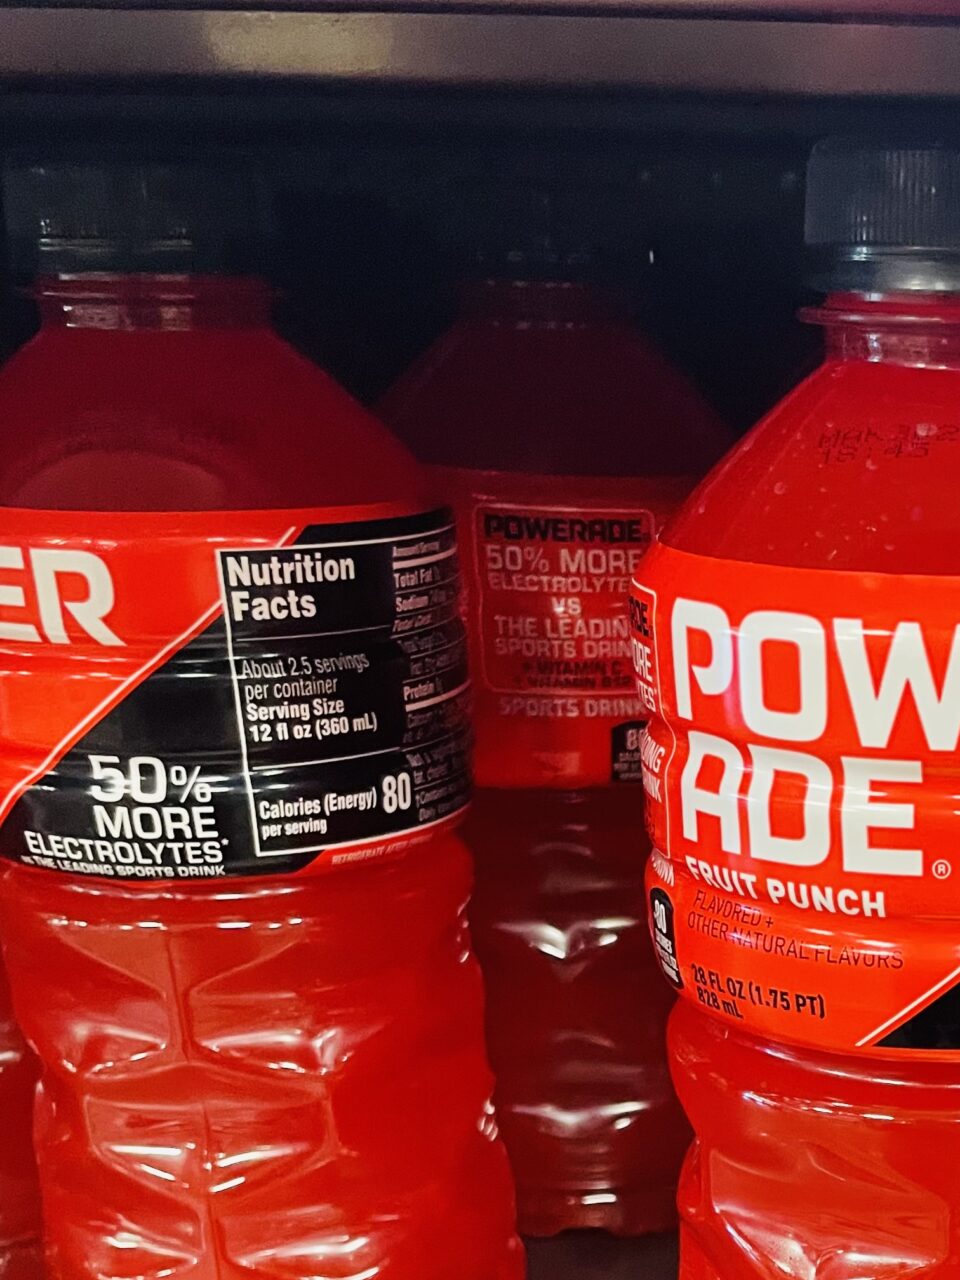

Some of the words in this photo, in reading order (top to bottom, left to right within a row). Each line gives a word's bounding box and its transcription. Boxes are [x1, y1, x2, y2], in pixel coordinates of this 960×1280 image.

[226, 553, 355, 587] Nutrition
[486, 544, 549, 572] 50%
[488, 573, 631, 593] ELECTROLYTE
[231, 590, 317, 622] Facts
[552, 597, 582, 615] VS
[494, 615, 537, 637] THE
[545, 616, 629, 639] LEADIN
[496, 638, 576, 658] SPORTS
[584, 640, 633, 658] DRIN
[242, 660, 286, 680] About
[289, 657, 312, 676] 2.5
[315, 652, 370, 673] servings
[245, 684, 269, 704] per
[273, 678, 338, 699] container
[246, 701, 310, 721] Serving
[313, 698, 344, 716] Size
[501, 698, 580, 717] SPORTS
[250, 724, 272, 742] 12
[276, 722, 289, 740] fl
[293, 724, 312, 739] oz
[316, 717, 349, 740] (360
[353, 712, 377, 732] mL)
[88, 755, 213, 804] 50%
[259, 797, 321, 820] Calories
[324, 786, 377, 816] (Energy)
[382, 772, 412, 814] 80
[93, 805, 219, 839] MORE
[261, 824, 282, 840] per
[284, 818, 327, 834] serving
[57, 860, 114, 875] LEADING
[116, 865, 175, 877] SPORTS
[178, 865, 226, 877] DRINK
[685, 855, 758, 900] FRUIT
[765, 878, 886, 918] PUNCH
[693, 890, 762, 927] FLAVORED
[687, 911, 728, 941] OTHER
[731, 929, 809, 960] NATURAL
[814, 946, 904, 970] FLAVORS
[691, 963, 707, 985] 28
[708, 971, 725, 994] FL
[727, 977, 746, 1000] OZ
[748, 981, 790, 1011] (1.75
[795, 993, 825, 1020] PT)
[697, 986, 719, 1011] 828
[722, 1003, 744, 1019] mL
